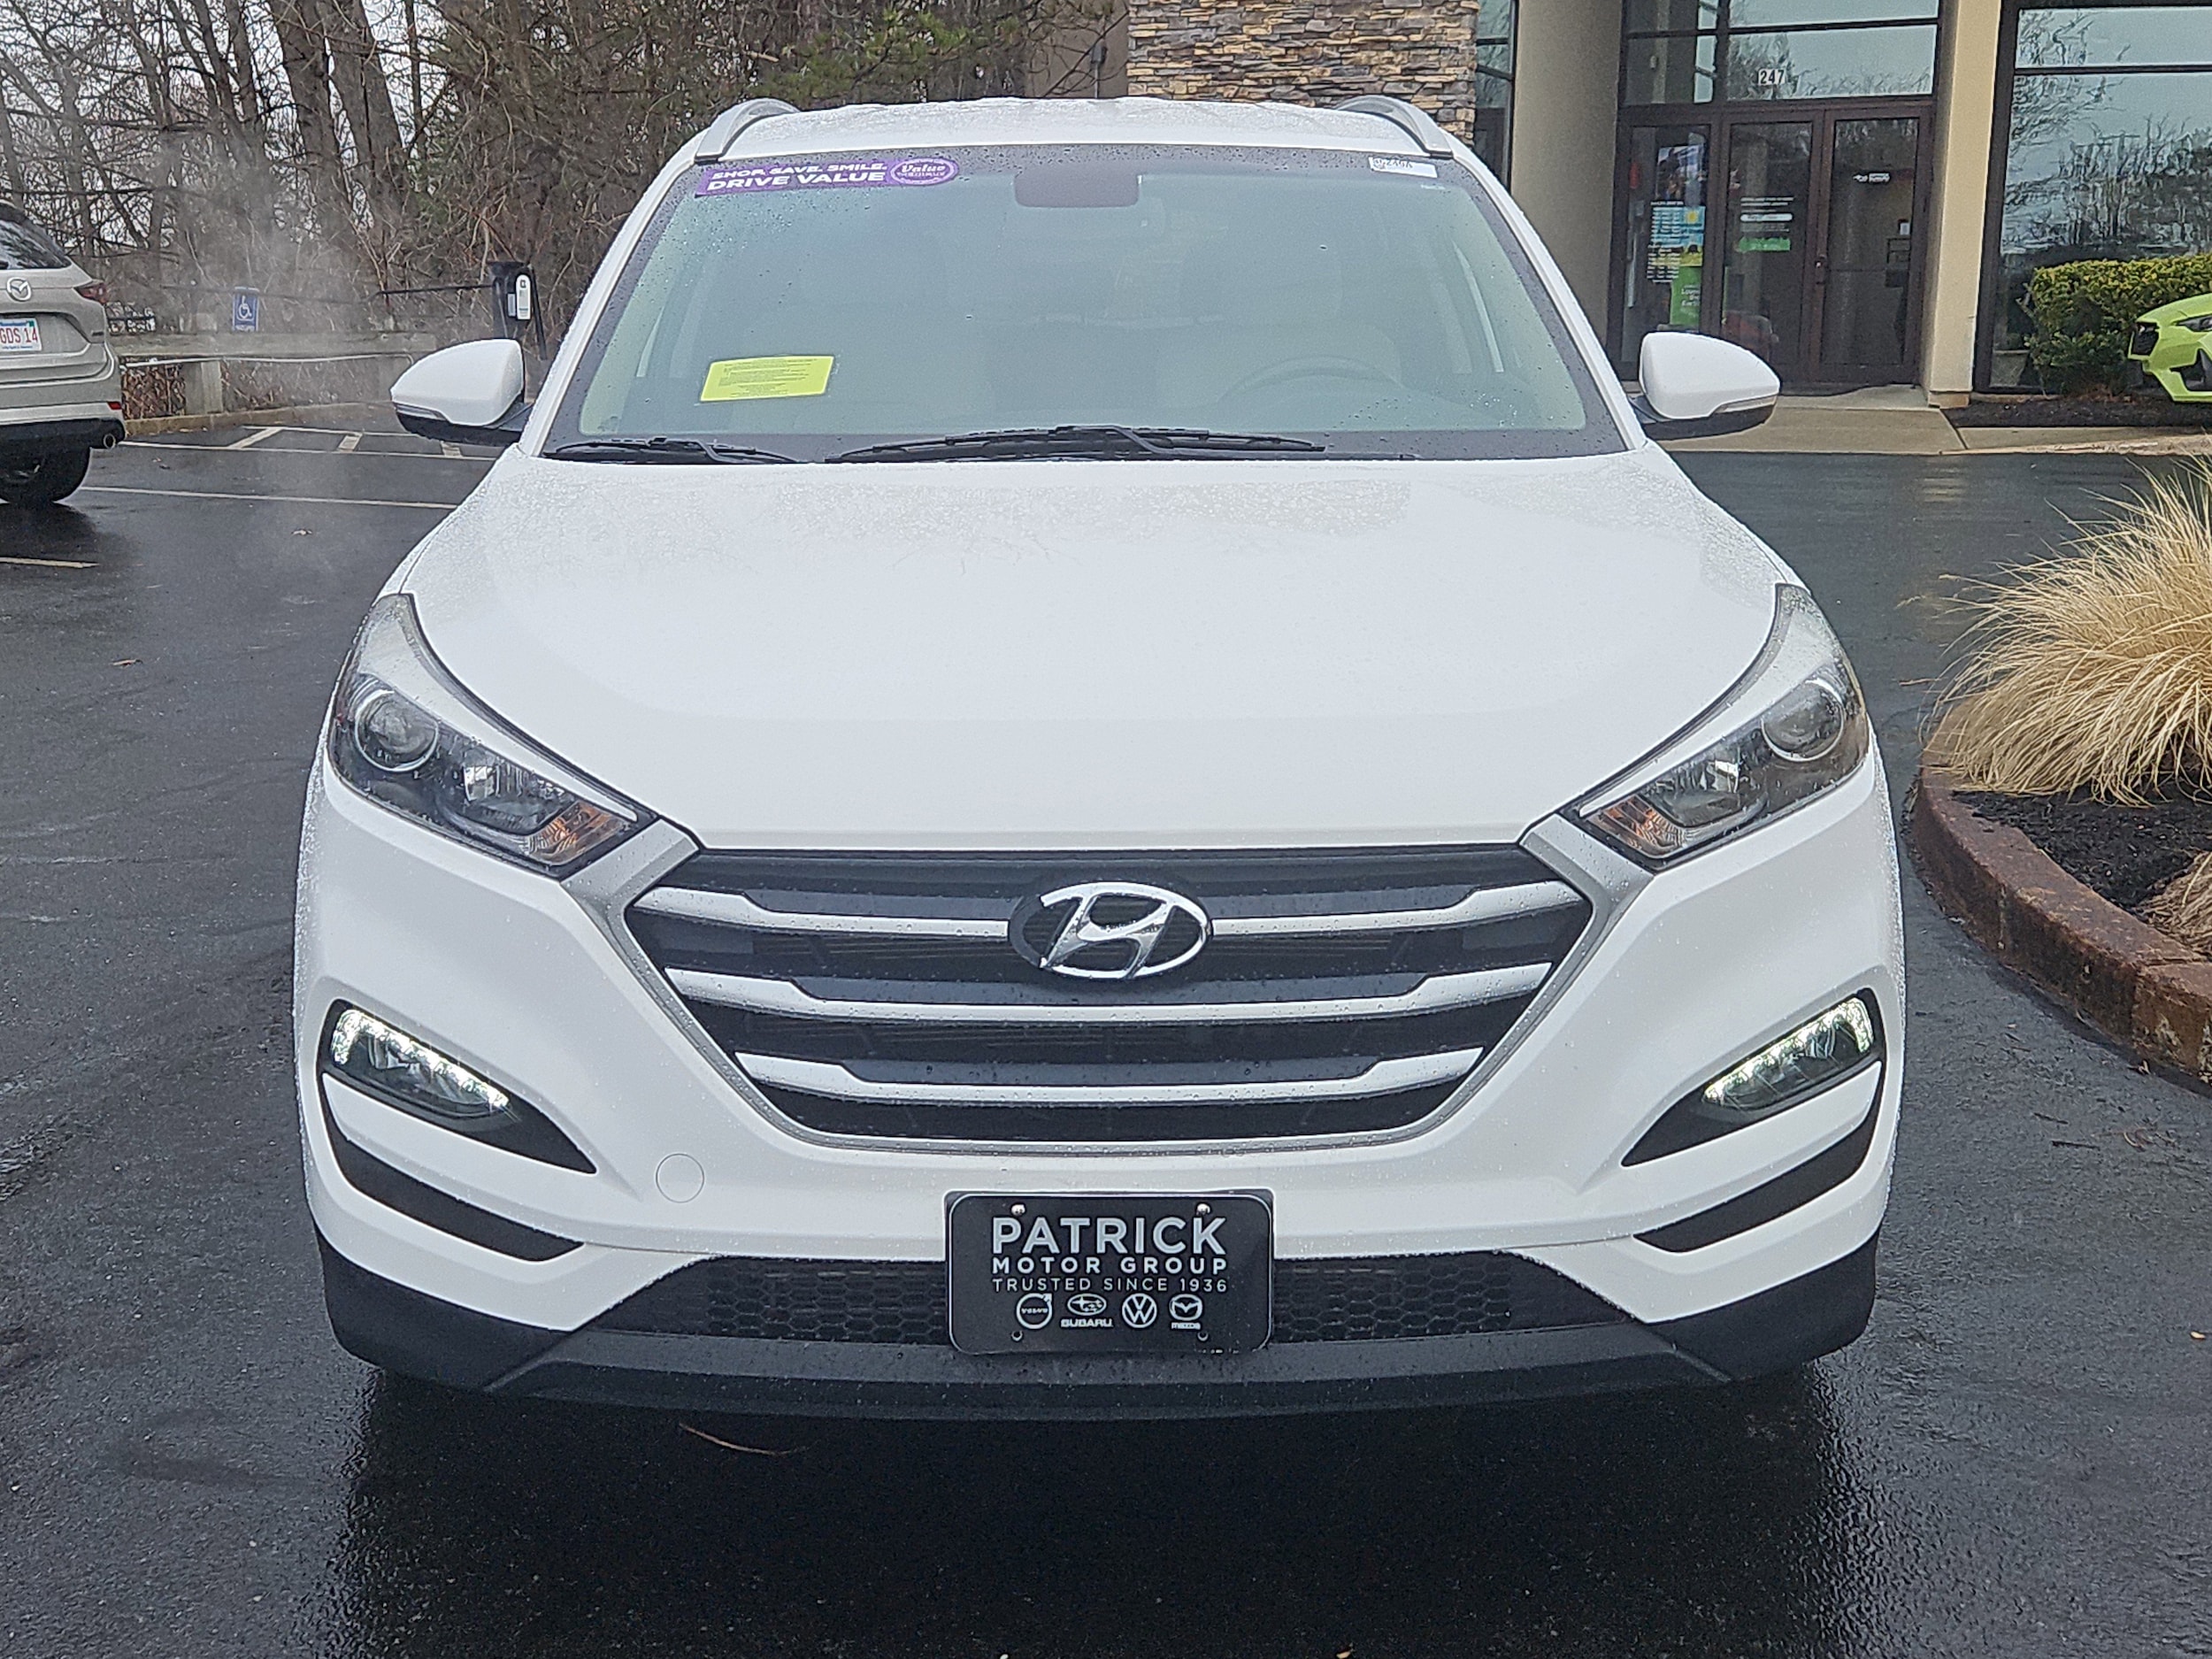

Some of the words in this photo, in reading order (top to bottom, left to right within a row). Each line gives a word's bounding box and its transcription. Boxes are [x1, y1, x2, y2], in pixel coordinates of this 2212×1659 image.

[1760, 69, 1784, 84] 247
[826, 163, 887, 172] SMILE.
[706, 175, 790, 191] DRIVE
[796, 172, 885, 184] VALUE
[24, 327, 38, 342] 14
[992, 1217, 1227, 1255] PATRICK
[992, 1256, 1101, 1274] MOTOR
[1120, 1256, 1227, 1274] GROUP
[992, 1278, 1091, 1292] TRUSTED
[1103, 1278, 1168, 1292] SINCE
[1180, 1278, 1227, 1292] 1936
[1061, 1318, 1112, 1327] SUBARU
